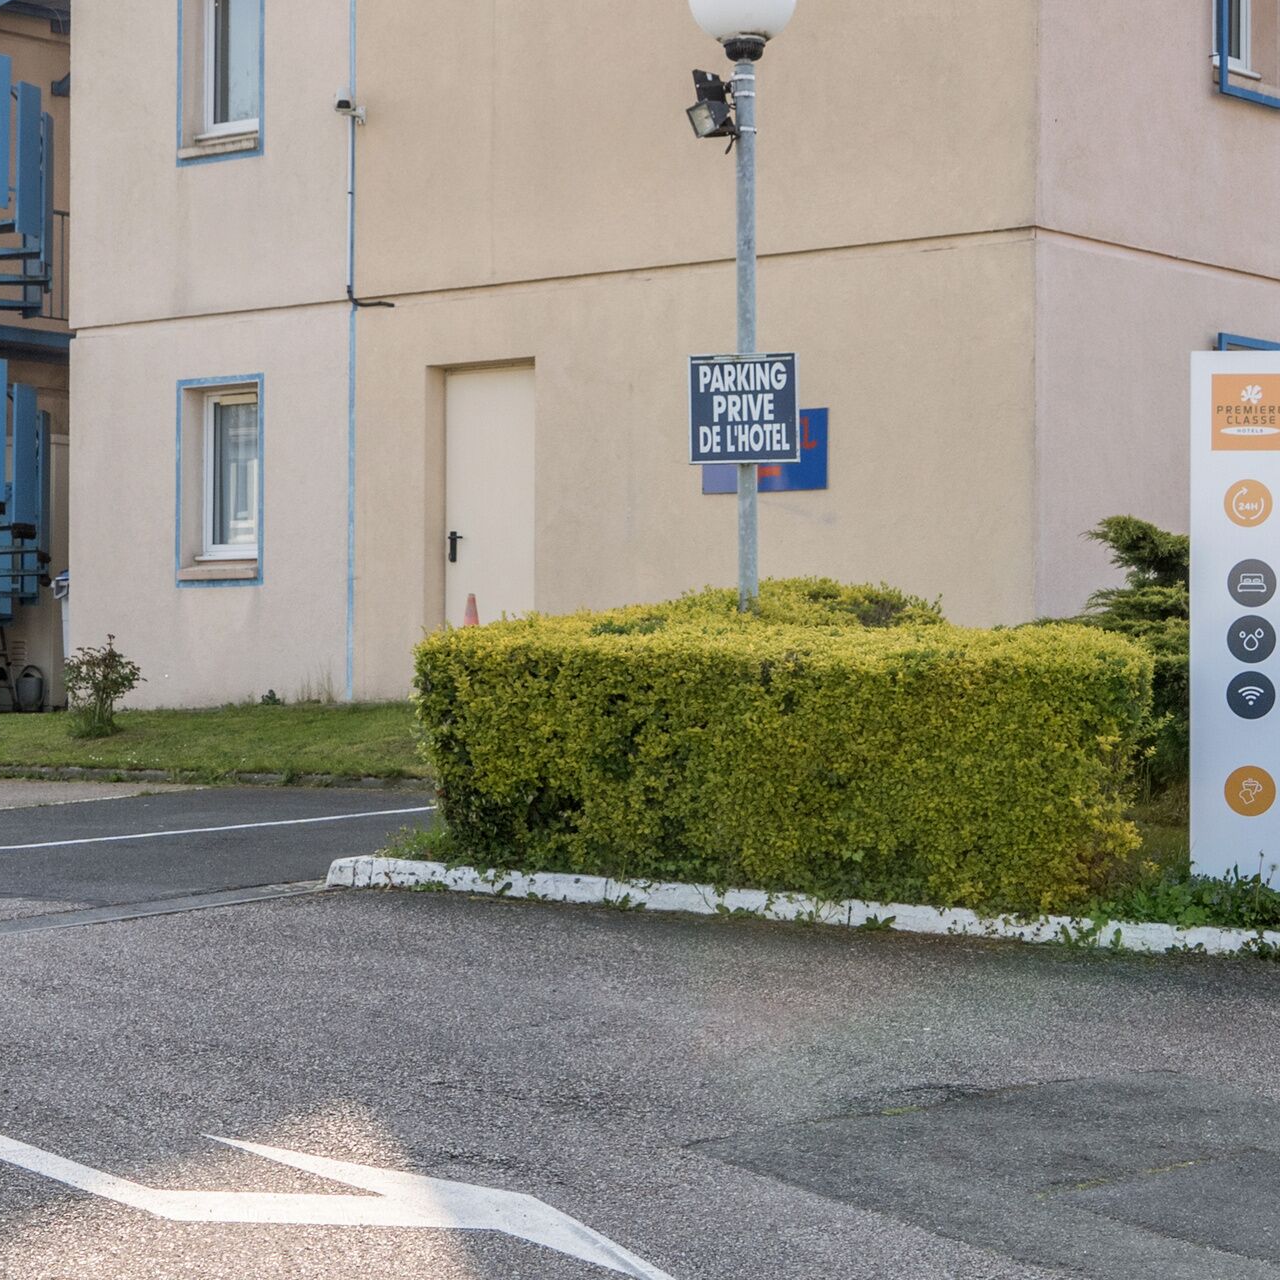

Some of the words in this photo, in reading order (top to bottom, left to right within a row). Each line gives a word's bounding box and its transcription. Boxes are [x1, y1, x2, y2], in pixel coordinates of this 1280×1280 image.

[699, 362, 787, 393] PARKING
[712, 393, 775, 422] PRIVE
[1226, 416, 1276, 425] CLASSE
[699, 426, 721, 453] DE
[726, 423, 790, 452] L'HOTEL
[1238, 502, 1258, 511] 24H
